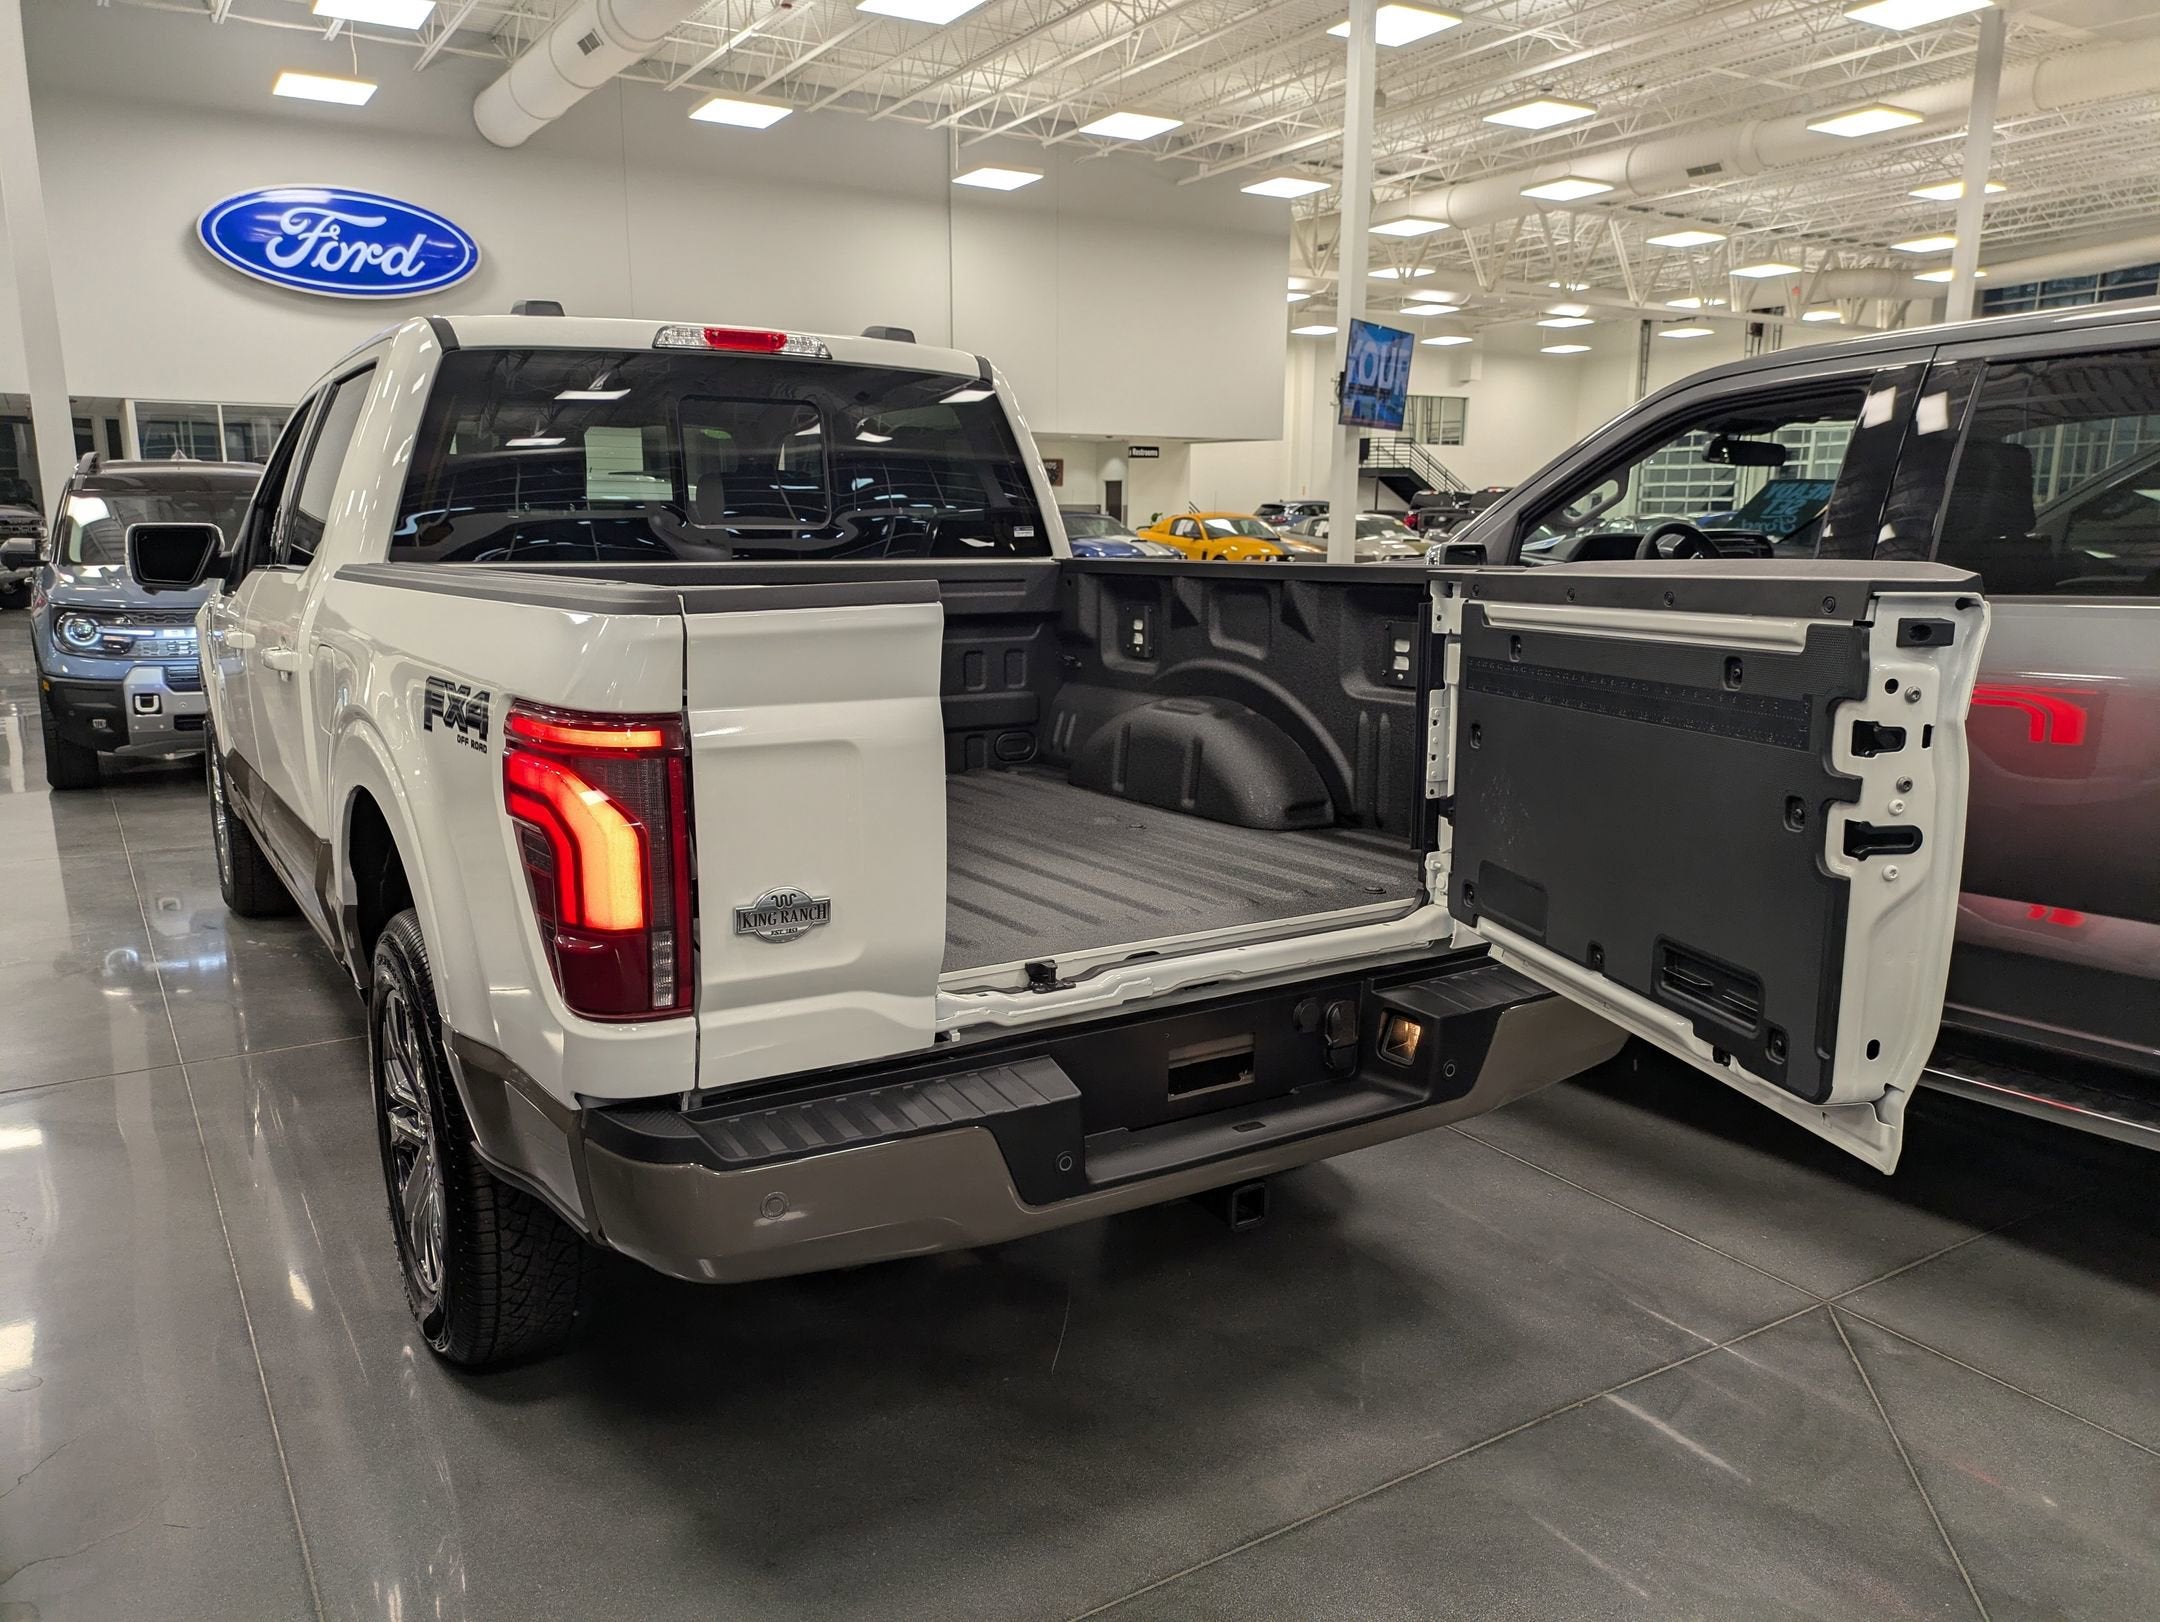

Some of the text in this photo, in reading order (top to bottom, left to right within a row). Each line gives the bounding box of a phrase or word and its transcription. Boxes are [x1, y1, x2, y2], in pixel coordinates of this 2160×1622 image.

[265, 206, 428, 278] Ford
[424, 675, 491, 742] FX4
[456, 734, 488, 754] OFF ROAD
[742, 903, 827, 929] KING RANCH
